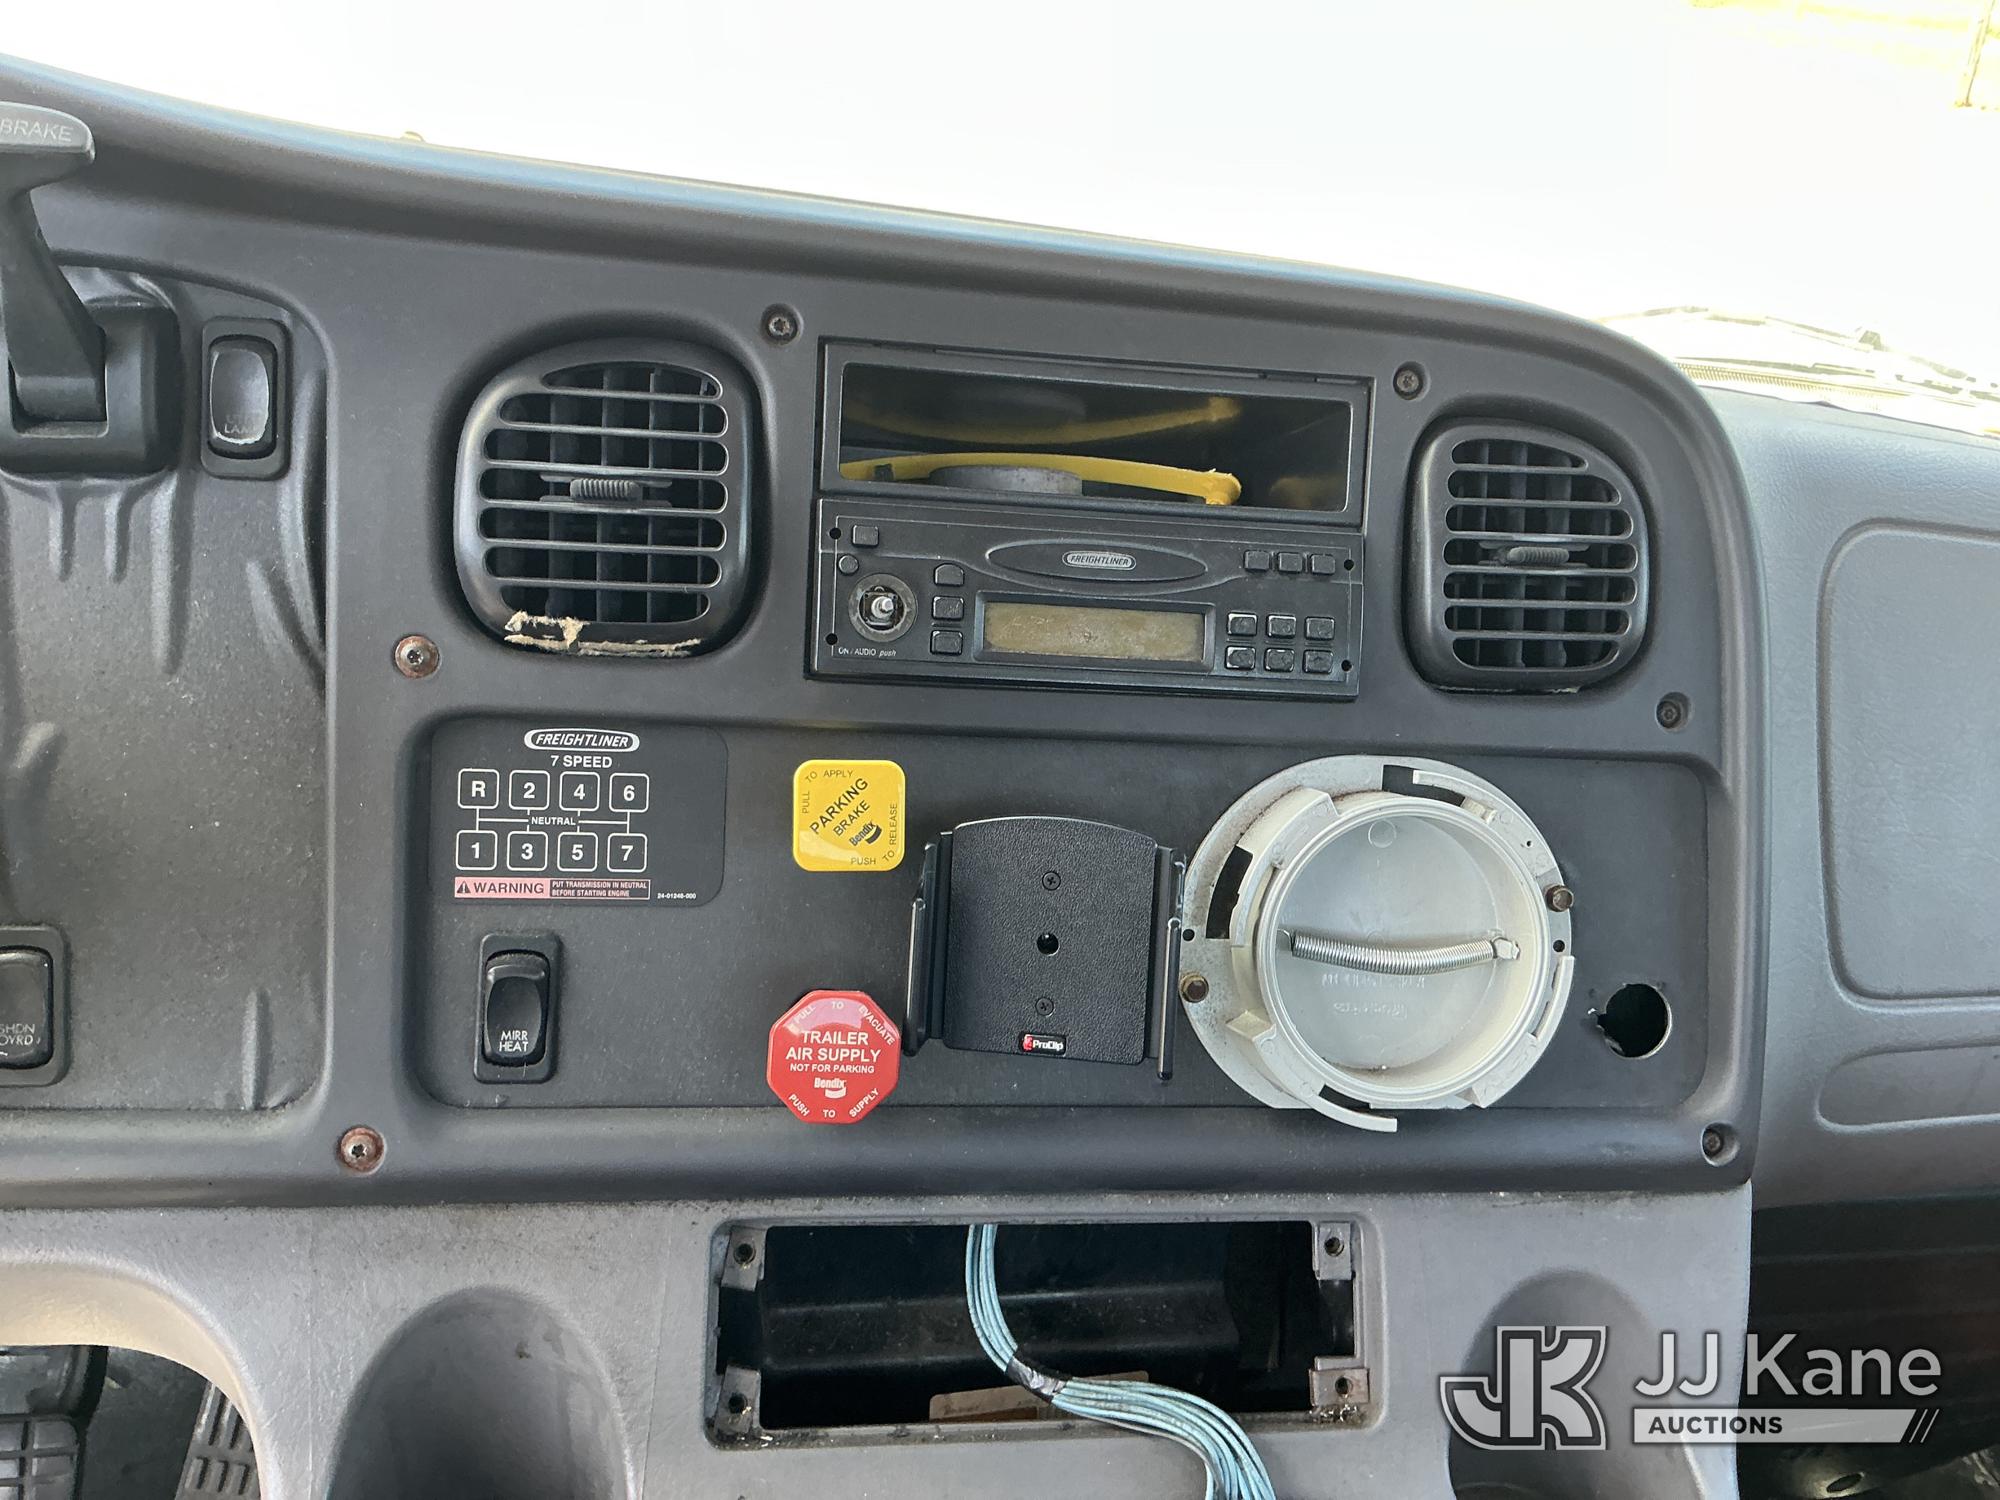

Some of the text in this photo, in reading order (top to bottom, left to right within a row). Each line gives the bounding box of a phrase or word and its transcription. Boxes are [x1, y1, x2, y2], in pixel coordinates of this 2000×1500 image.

[0, 118, 73, 142] BRAKE
[1070, 554, 1129, 566] FREIGHTLINER
[838, 646, 849, 655] ON
[854, 648, 877, 656] AUDIO
[878, 649, 897, 658] push
[536, 733, 629, 748] FREIGHTLINER
[550, 755, 613, 769] 7 SPEED
[471, 781, 635, 802] R 2 4 6
[802, 769, 853, 814] PULL TO APPLY
[809, 778, 868, 835] PARKING
[531, 816, 577, 826] NEUTRAL
[833, 800, 870, 836] BRAKE
[849, 820, 876, 847] Bendix
[850, 803, 898, 865] PUSH TO RELEASE
[471, 842, 634, 861] 1 3 5 7
[474, 882, 544, 894] WARNING
[620, 881, 647, 889] NEUTRAL
[552, 889, 575, 897] BEFORE
[576, 889, 607, 897] STARTING
[795, 1001, 895, 1046] PULL TO EVACUATE
[501, 1029, 528, 1041] MIRR
[801, 1030, 869, 1046] TRAILER
[499, 1041, 529, 1052] HEAT
[1032, 1039, 1064, 1051] ProClip
[785, 1046, 881, 1063] AIR SUPPLY
[790, 1063, 875, 1074] NOT FOR PARKING
[814, 1077, 846, 1089] Bendix
[789, 1088, 879, 1118] PUSH TO SUPPLY
